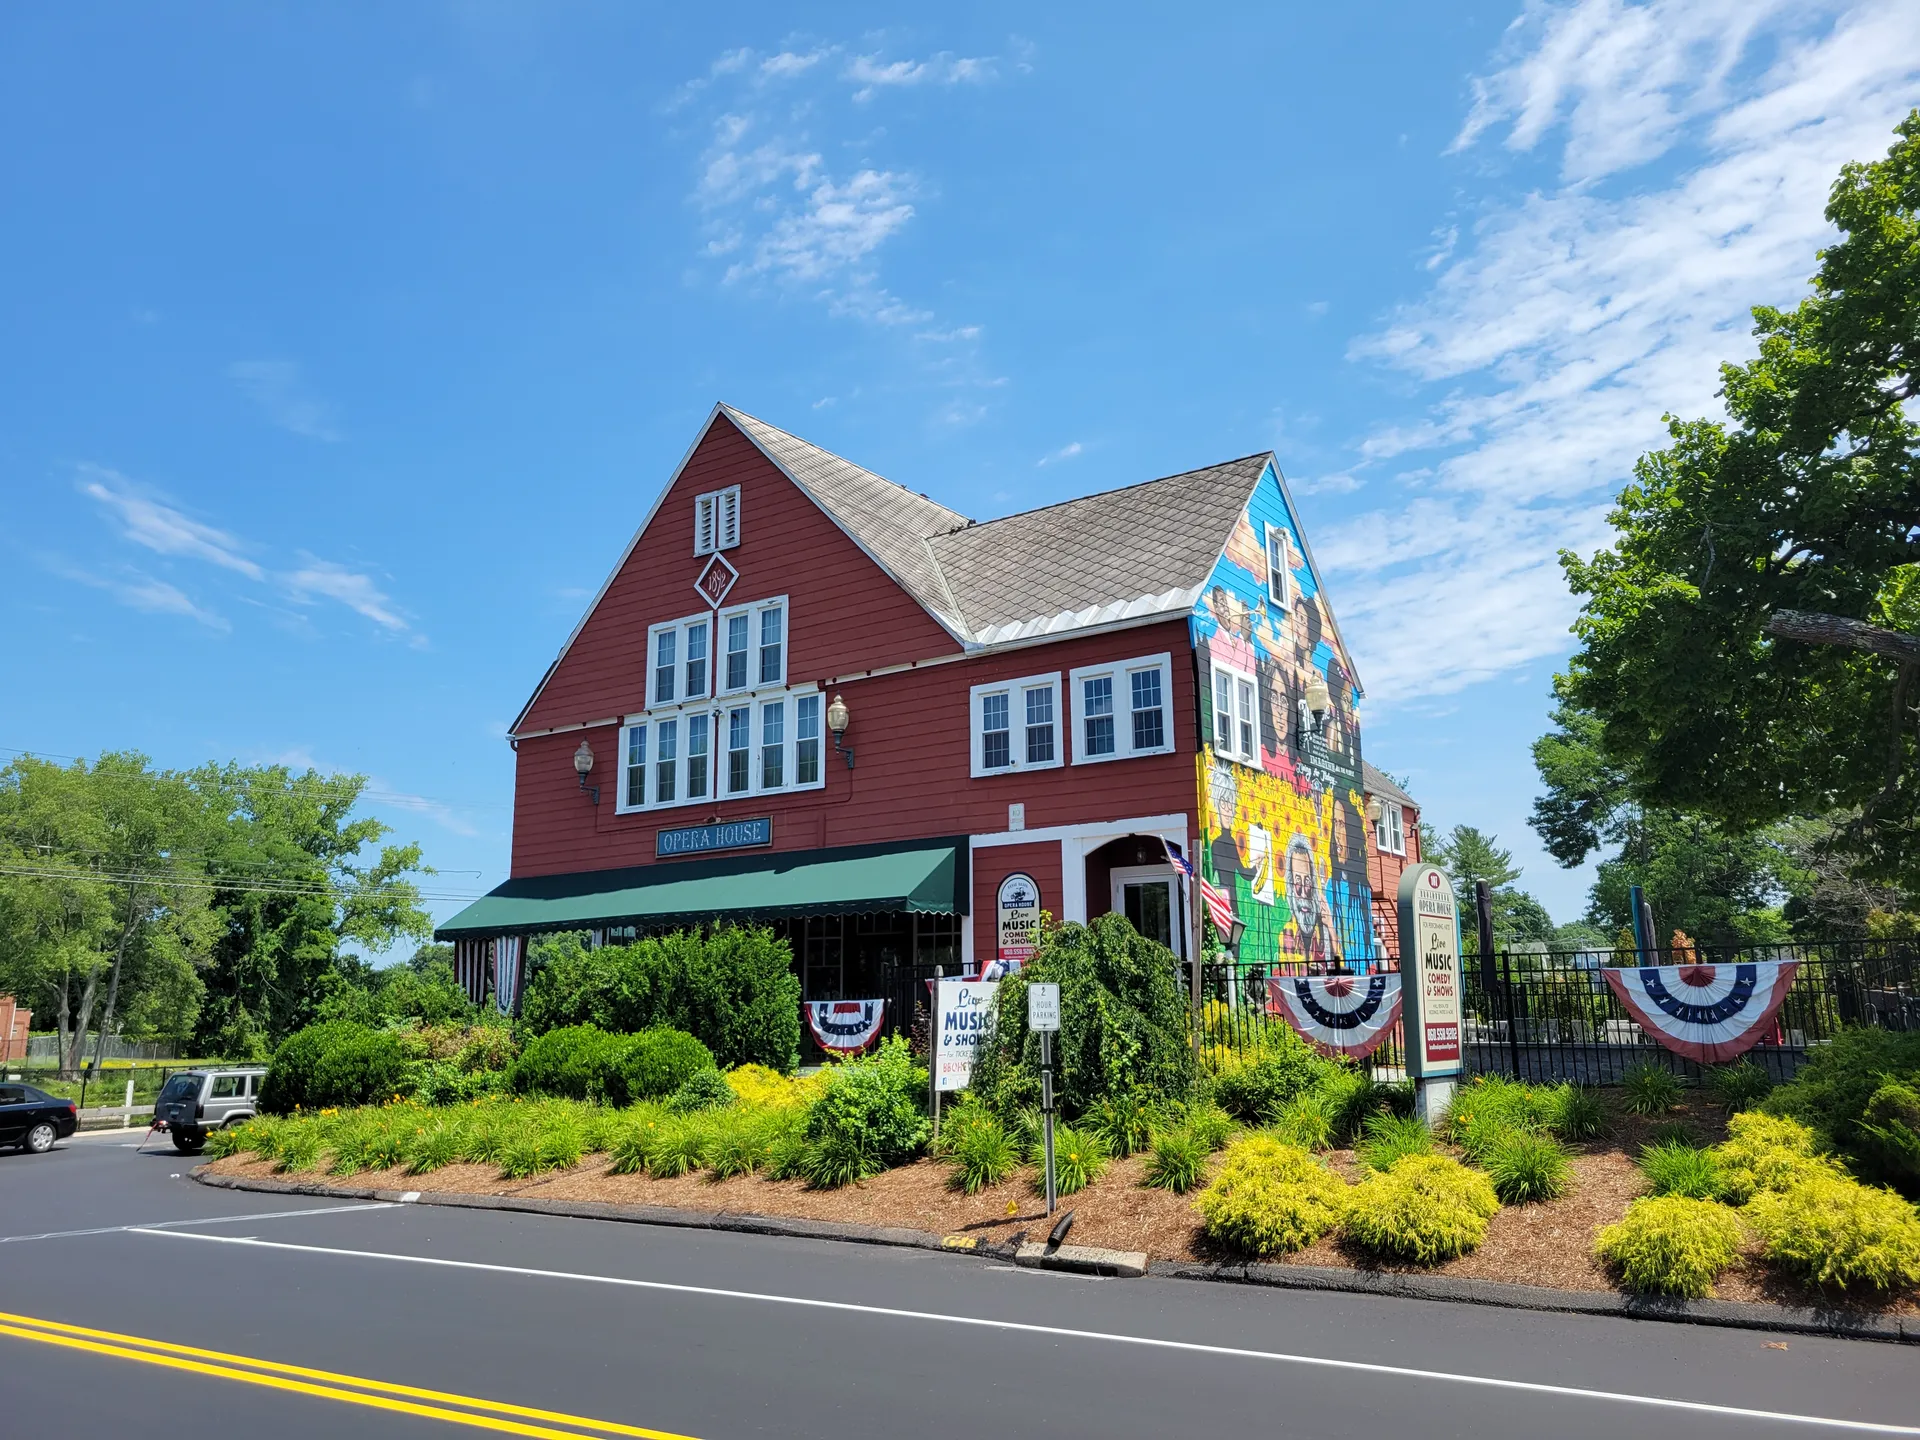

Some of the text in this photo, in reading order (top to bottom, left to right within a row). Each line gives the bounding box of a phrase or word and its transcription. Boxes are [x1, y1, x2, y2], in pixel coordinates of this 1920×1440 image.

[708, 569, 727, 598] 1892
[664, 822, 761, 852] OPERA HOUSE
[1418, 900, 1452, 916] OPERA HOUSE
[1009, 909, 1029, 920] Live
[1002, 919, 1037, 931] MUSIC
[1430, 932, 1446, 951] Live
[1425, 952, 1452, 971] MUSIC
[1428, 973, 1451, 985] COMEDY
[1041, 986, 1047, 997] 2
[1426, 985, 1454, 997] & SHOWS
[1036, 1001, 1053, 1009] HOUR
[1032, 1011, 1057, 1020] PARKING
[943, 1033, 983, 1047] & SHO
